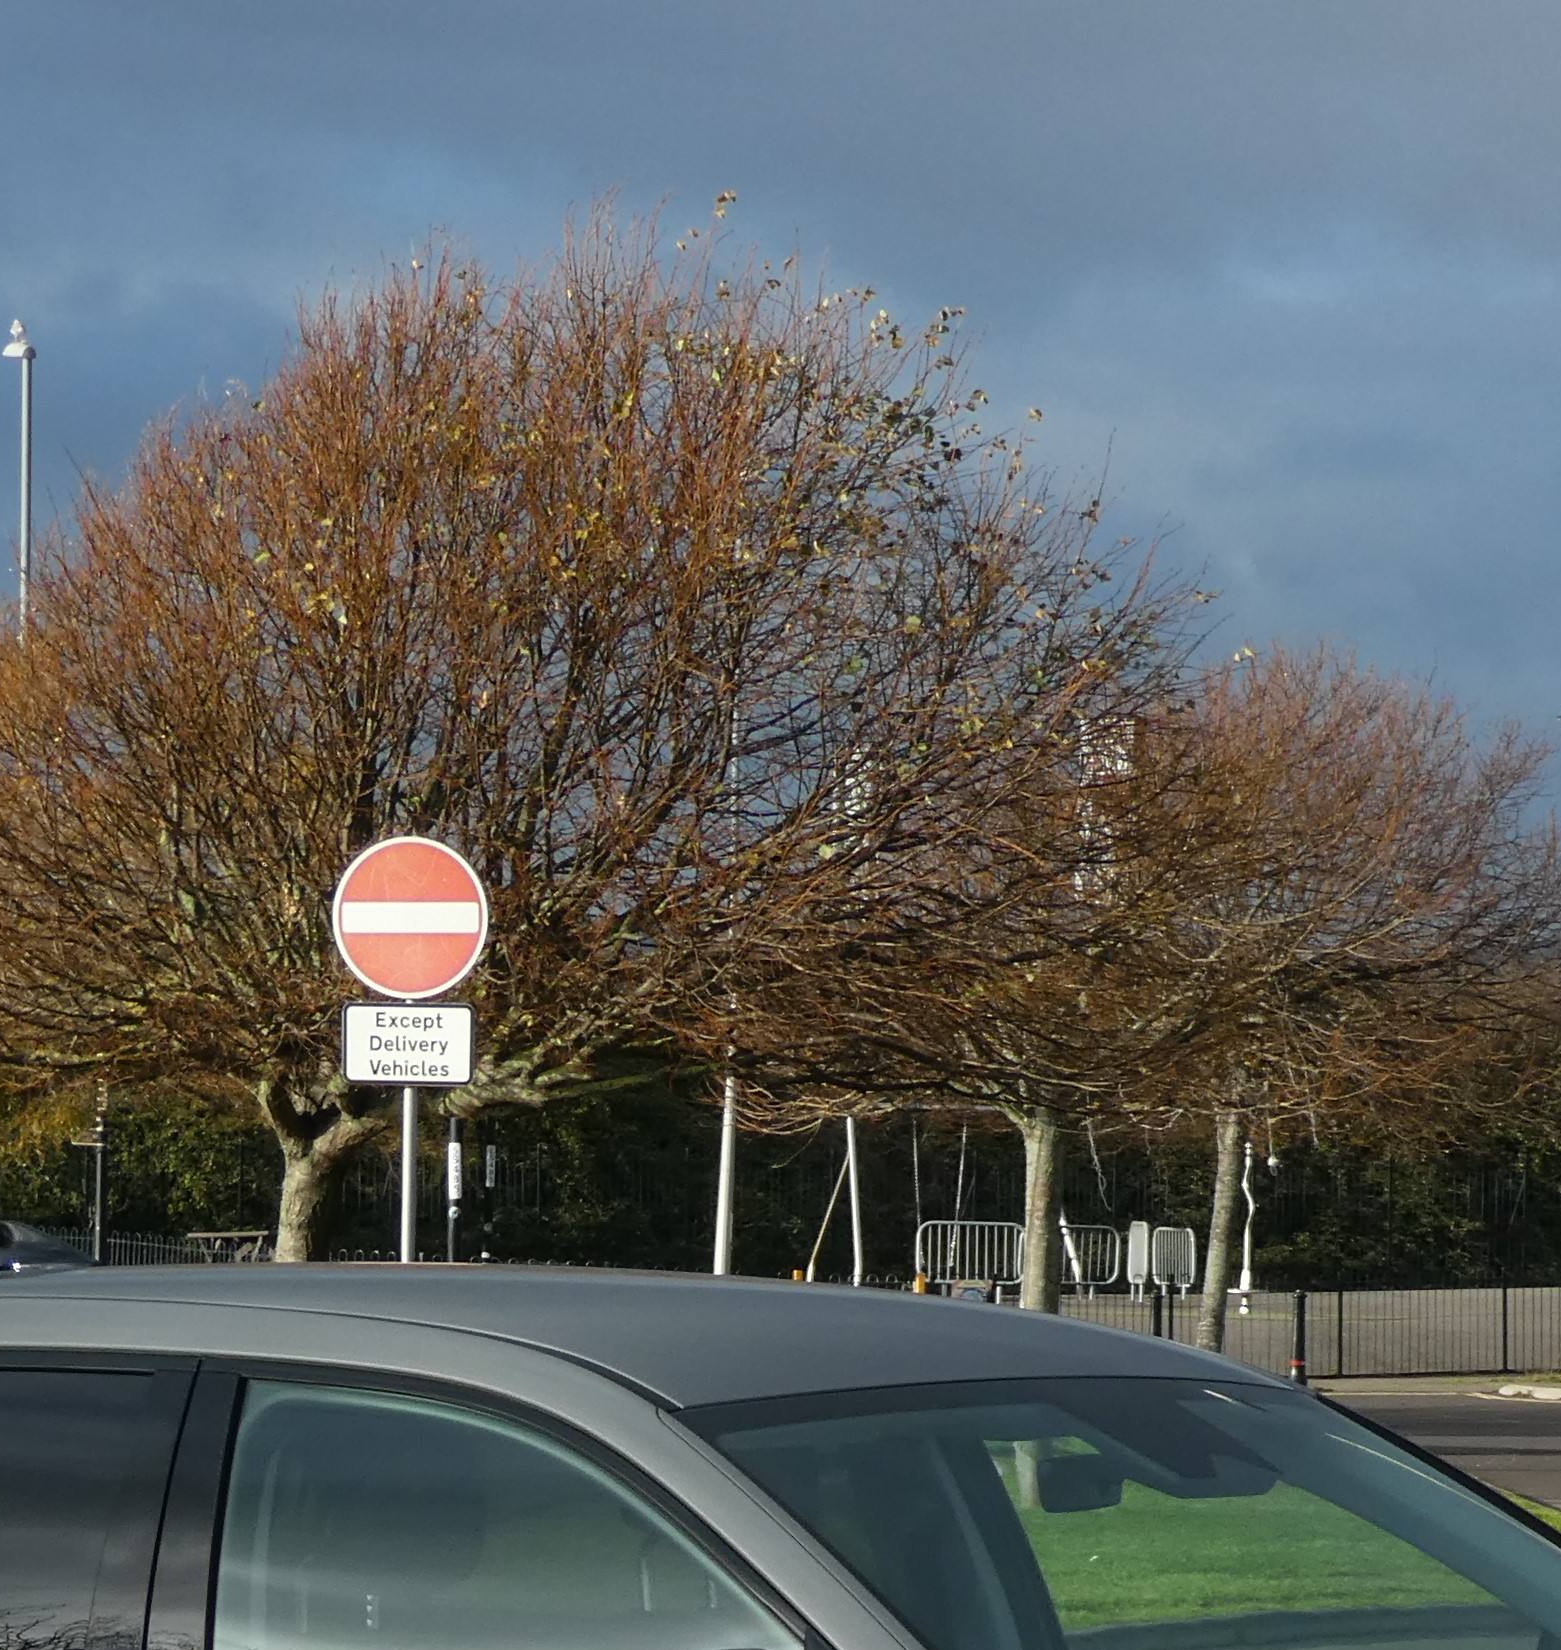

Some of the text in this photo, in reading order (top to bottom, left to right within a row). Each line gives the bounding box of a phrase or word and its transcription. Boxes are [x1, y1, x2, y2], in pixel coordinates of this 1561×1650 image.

[375, 1011, 443, 1031] Except
[369, 1035, 448, 1056] Delivery
[369, 1059, 449, 1078] Vehicles
